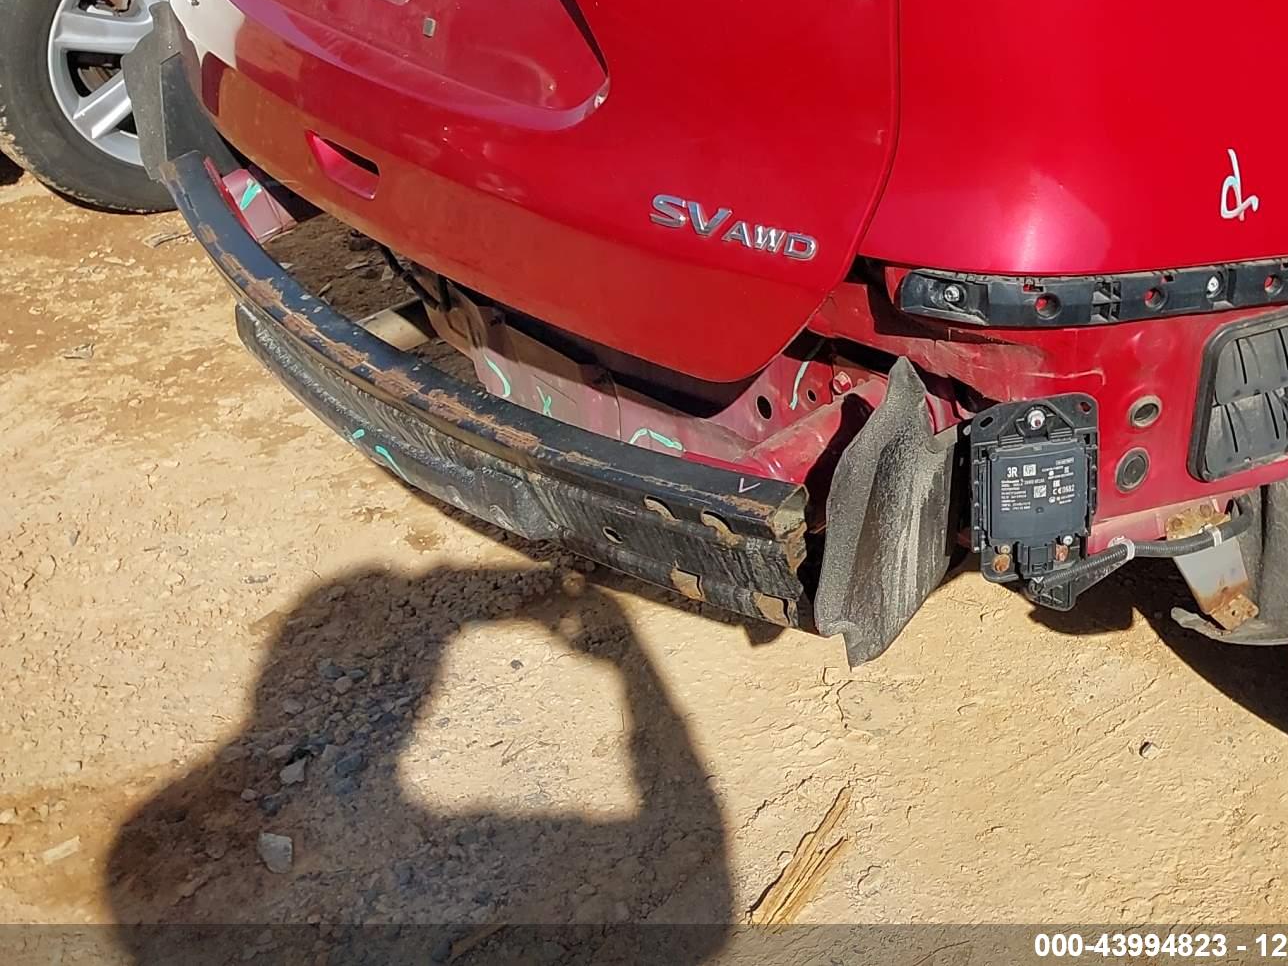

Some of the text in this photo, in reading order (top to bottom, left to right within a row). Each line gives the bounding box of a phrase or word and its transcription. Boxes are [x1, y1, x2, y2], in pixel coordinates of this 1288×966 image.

[650, 193, 818, 261] SV AWD
[1007, 466, 1018, 478] 3R
